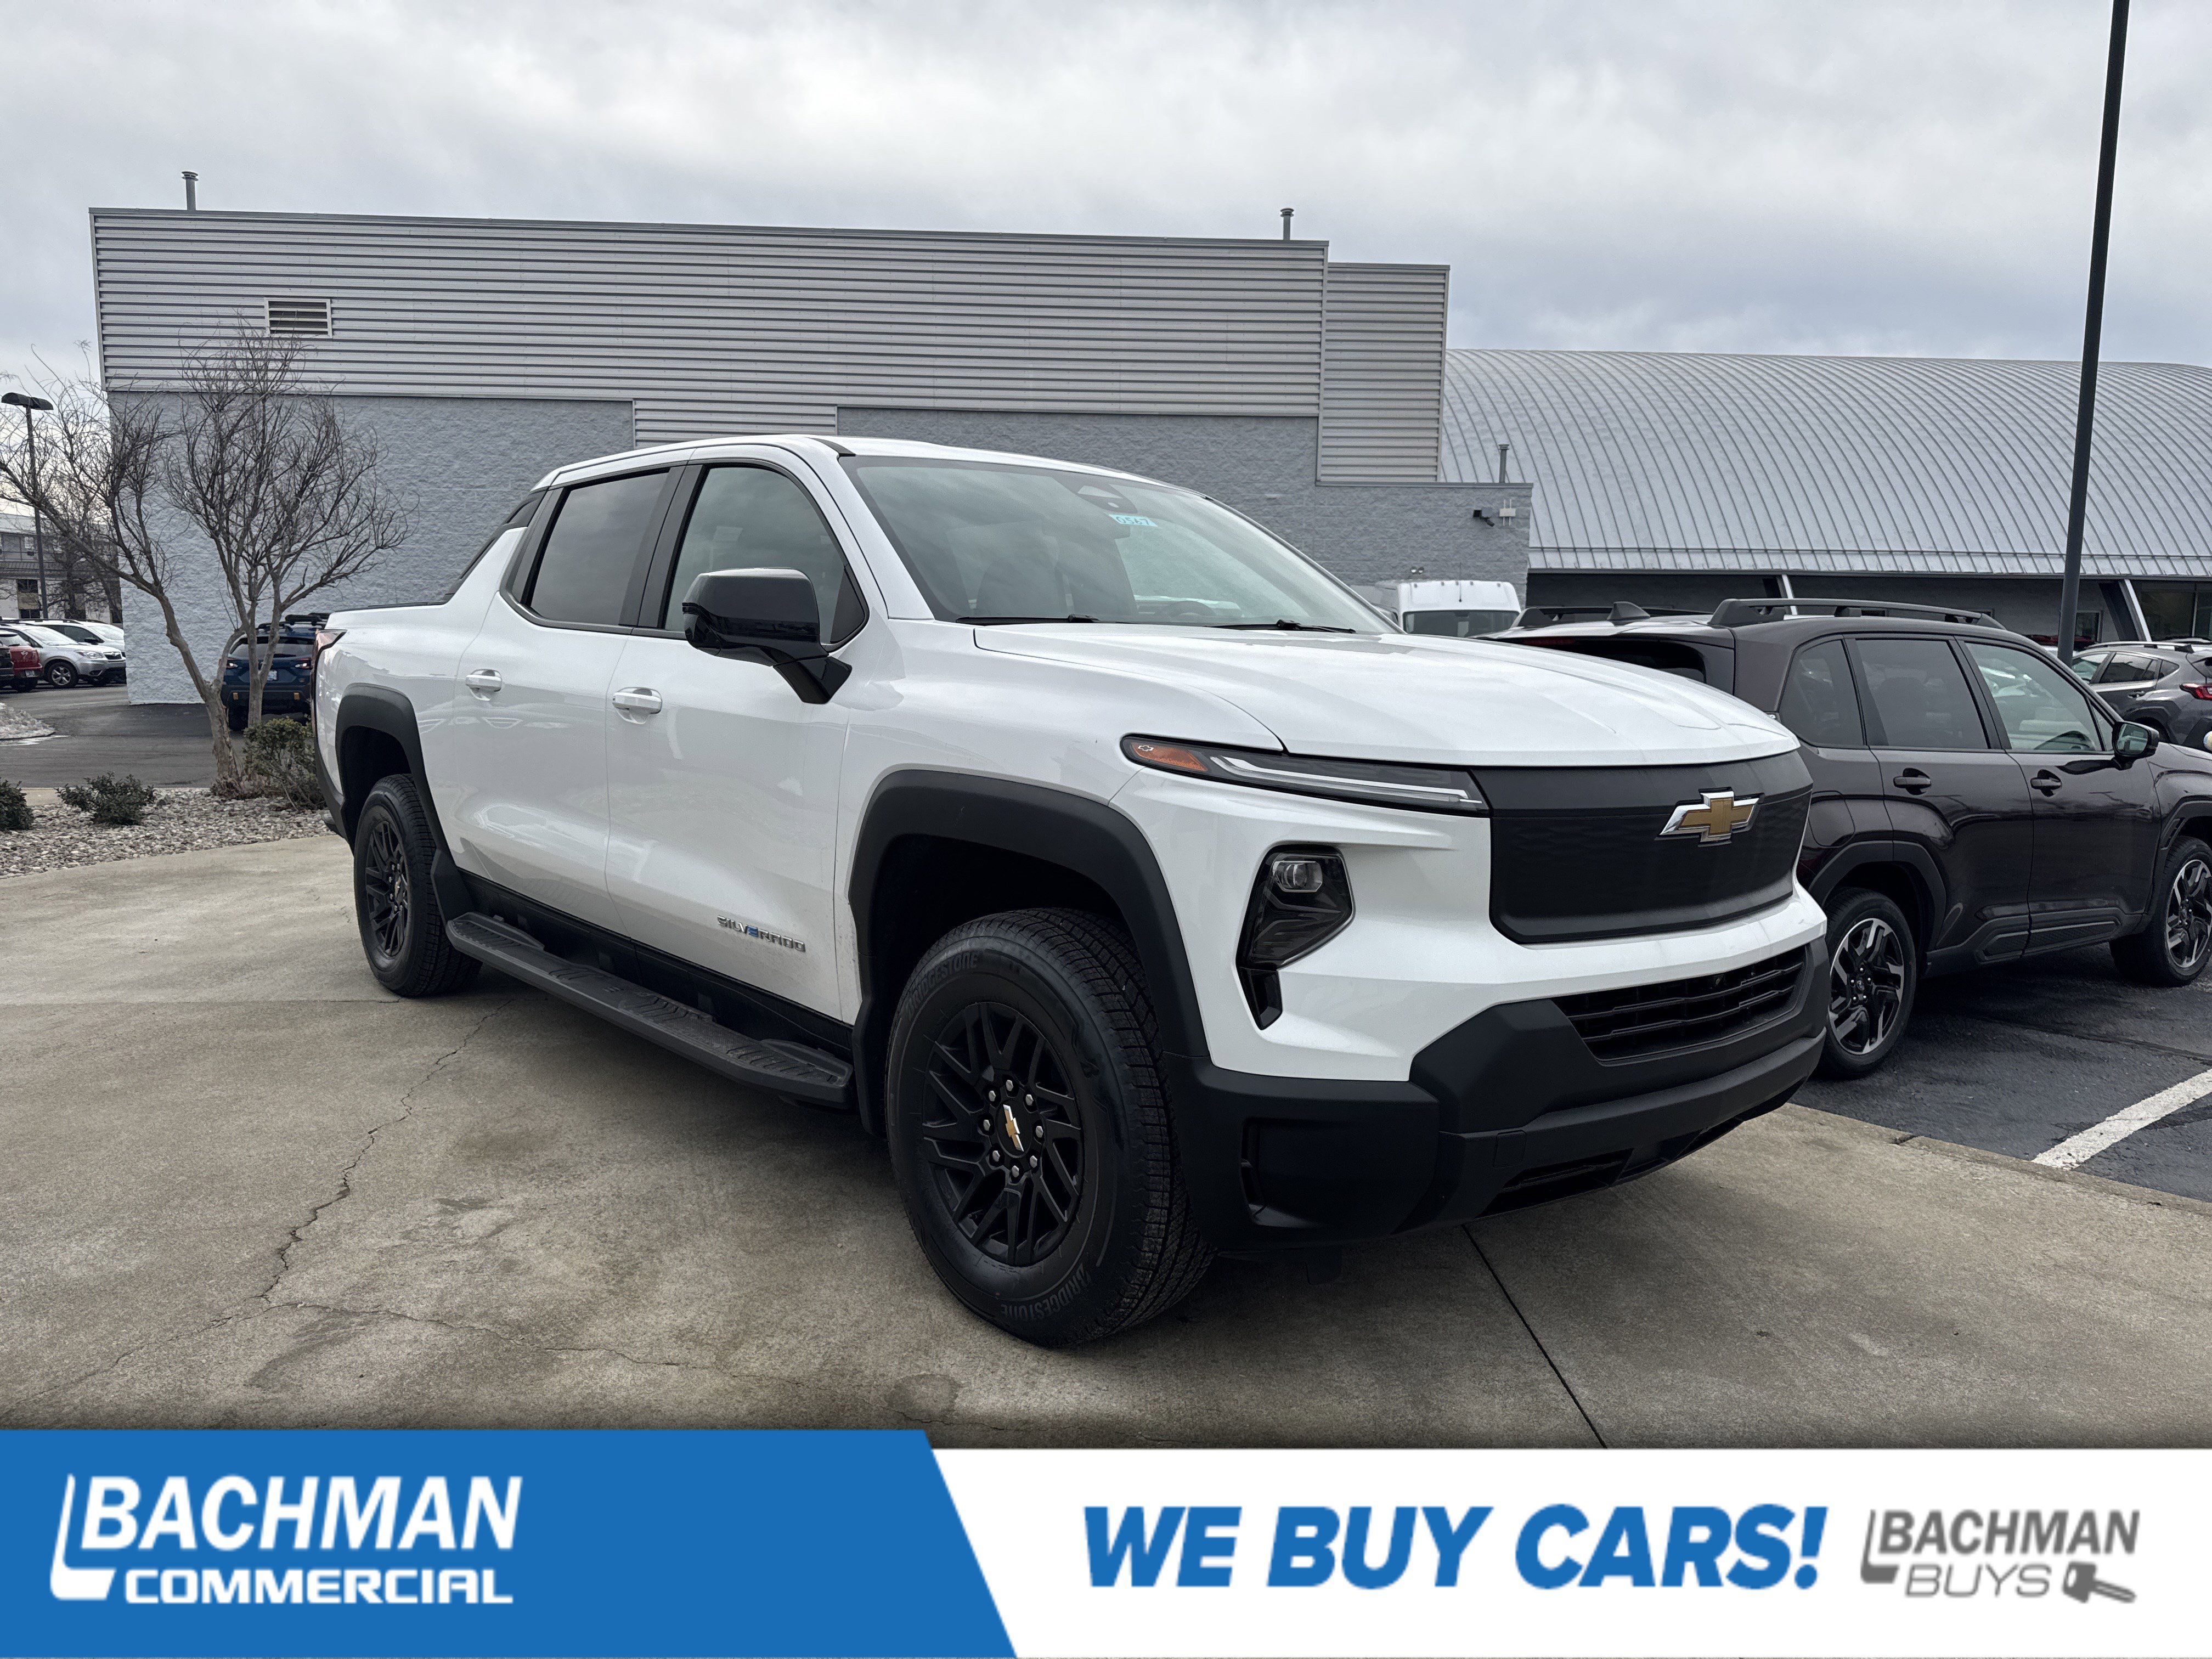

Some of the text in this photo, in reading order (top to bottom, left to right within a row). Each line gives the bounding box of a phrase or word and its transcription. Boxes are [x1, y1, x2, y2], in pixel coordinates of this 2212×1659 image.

[716, 915, 806, 952] SILVERADO
[901, 952, 980, 1022] BRIDGESTONE
[1001, 1263, 1092, 1322] BRIDGESTONE
